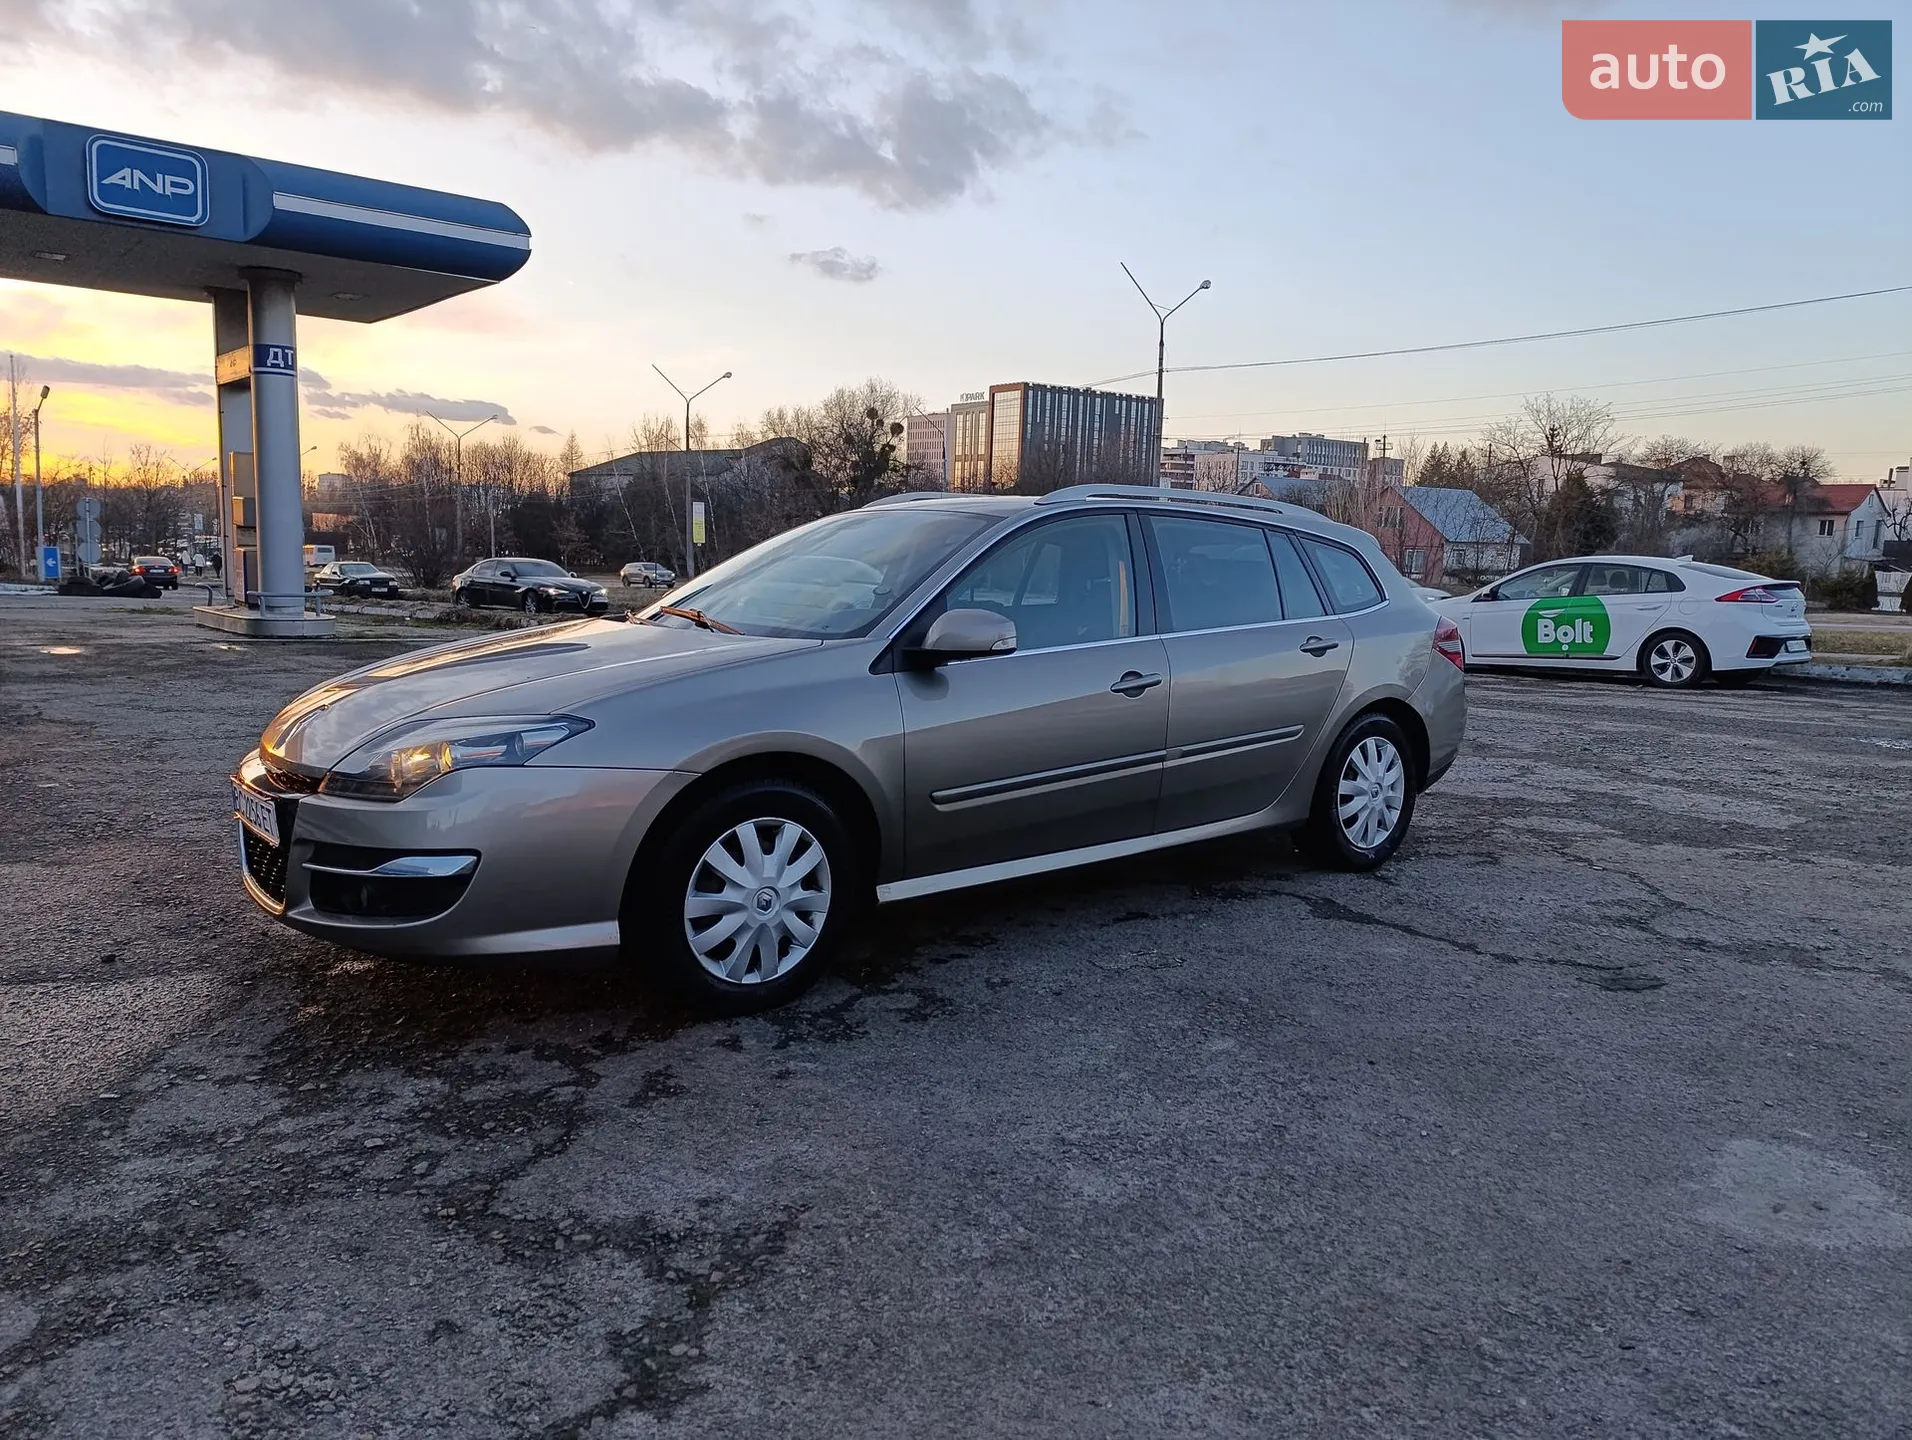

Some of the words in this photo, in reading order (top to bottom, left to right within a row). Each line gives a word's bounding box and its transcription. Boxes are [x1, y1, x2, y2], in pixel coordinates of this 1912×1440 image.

[101, 167, 195, 196] ANP
[266, 347, 294, 368] ДТ
[1537, 618, 1594, 647] Bolt
